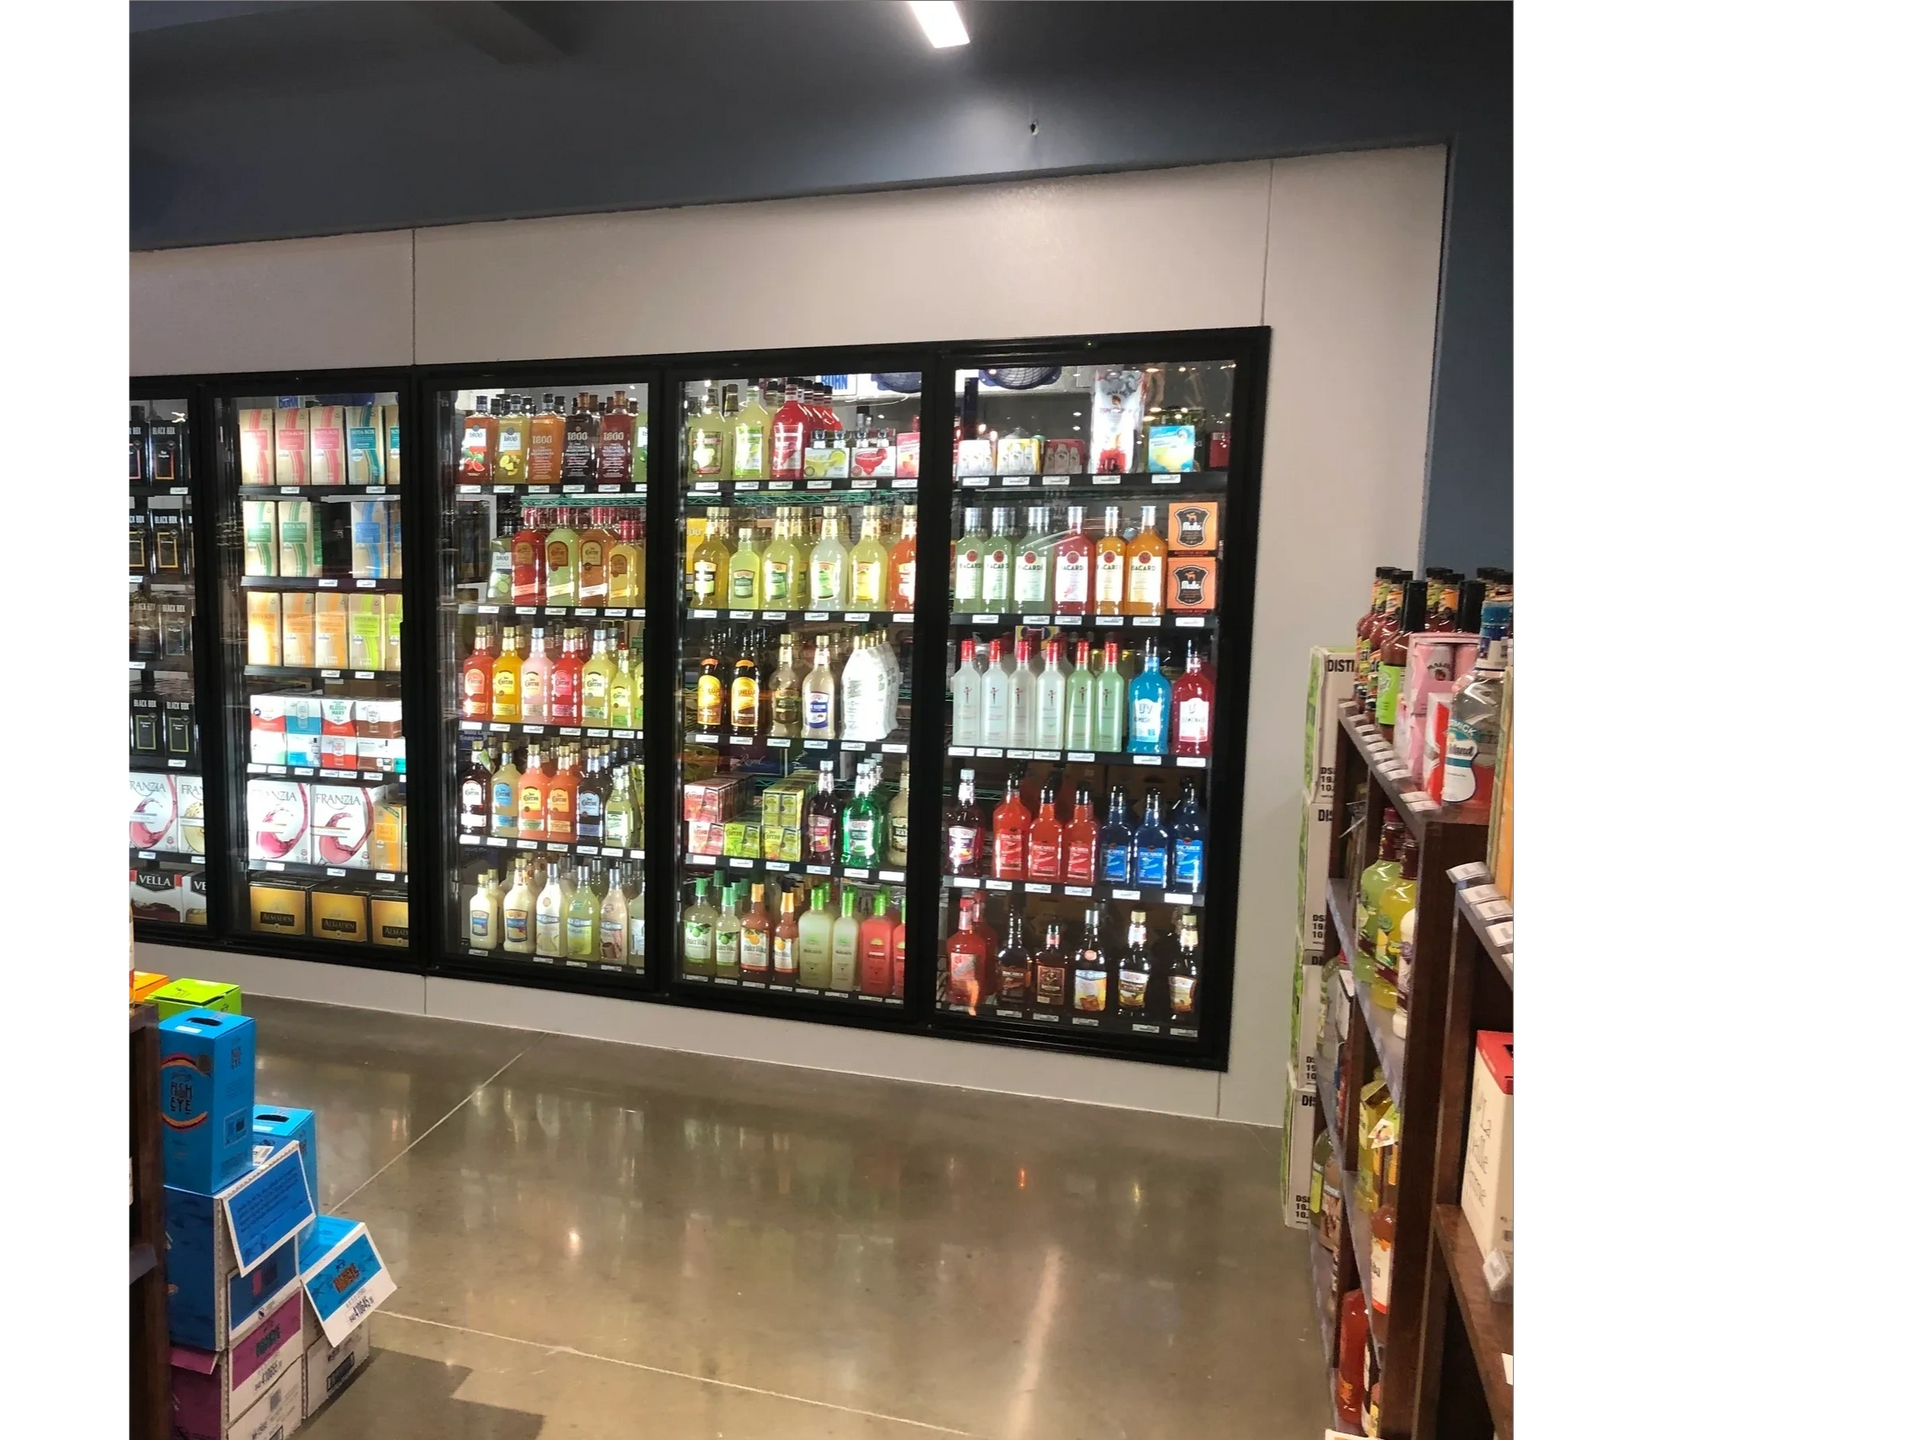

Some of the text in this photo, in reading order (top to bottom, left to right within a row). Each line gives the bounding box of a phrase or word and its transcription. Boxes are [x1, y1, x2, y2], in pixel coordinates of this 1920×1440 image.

[532, 436, 552, 444] 1800
[567, 431, 588, 441] 1800
[603, 431, 624, 441] 1800
[316, 793, 361, 809] FRANZIA
[138, 874, 172, 886] VELLA
[194, 880, 206, 890] VE
[262, 912, 293, 924] ALMADEN
[323, 919, 355, 930] ALMADEN
[170, 1096, 191, 1115] EYE
